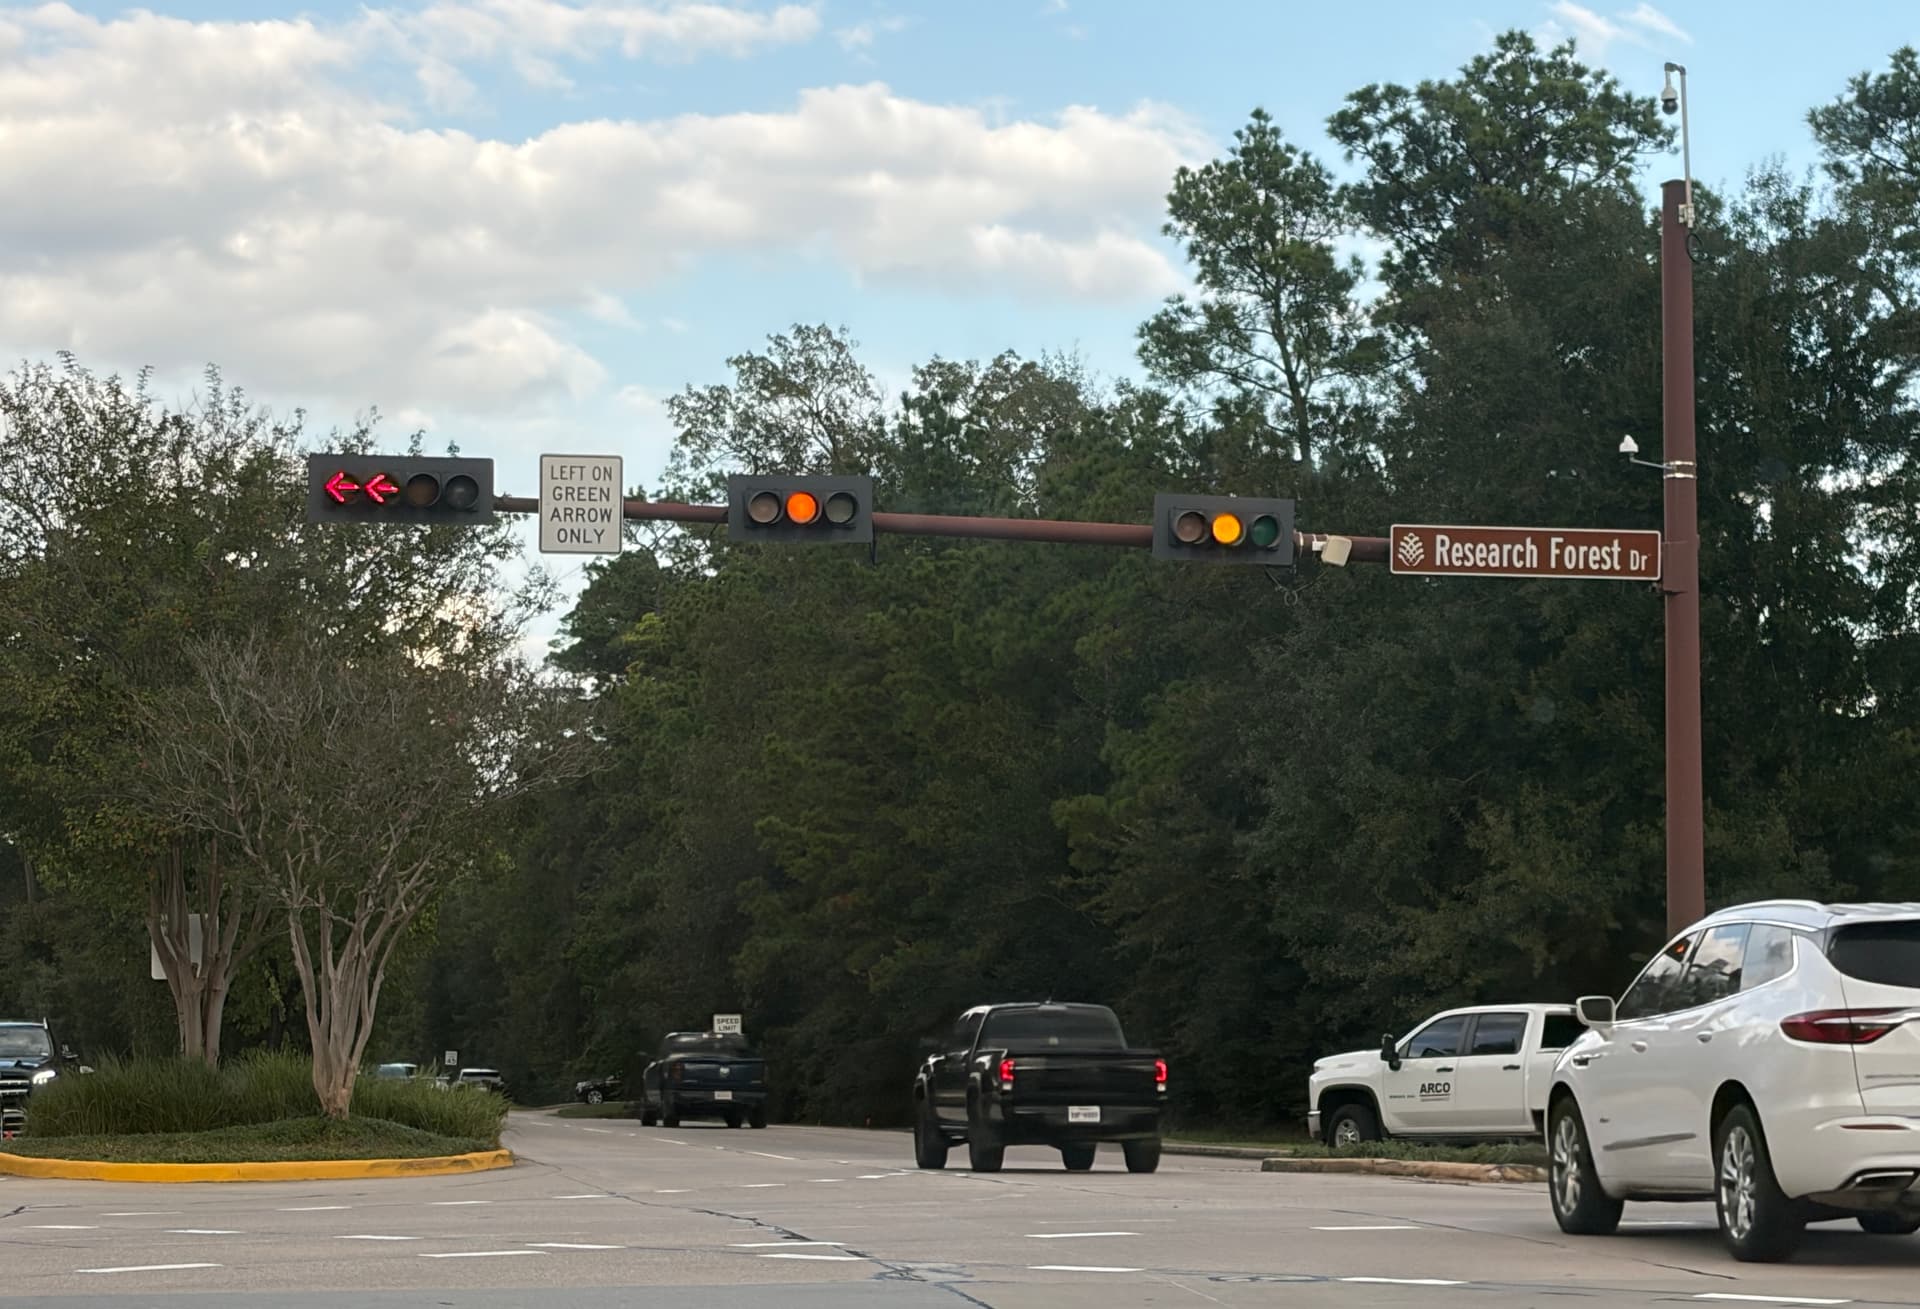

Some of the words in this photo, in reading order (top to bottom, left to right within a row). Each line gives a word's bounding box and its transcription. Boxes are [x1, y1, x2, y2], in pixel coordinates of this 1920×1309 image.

[551, 465, 586, 481] LEFT
[592, 466, 612, 481] ON
[552, 486, 610, 502] GREEN
[550, 507, 612, 523] ARROW
[557, 528, 605, 544] ONLY
[1435, 534, 1538, 569] Research
[1550, 537, 1621, 571] Forest
[1630, 550, 1648, 571] Dr
[1420, 1082, 1451, 1093] ARCO
